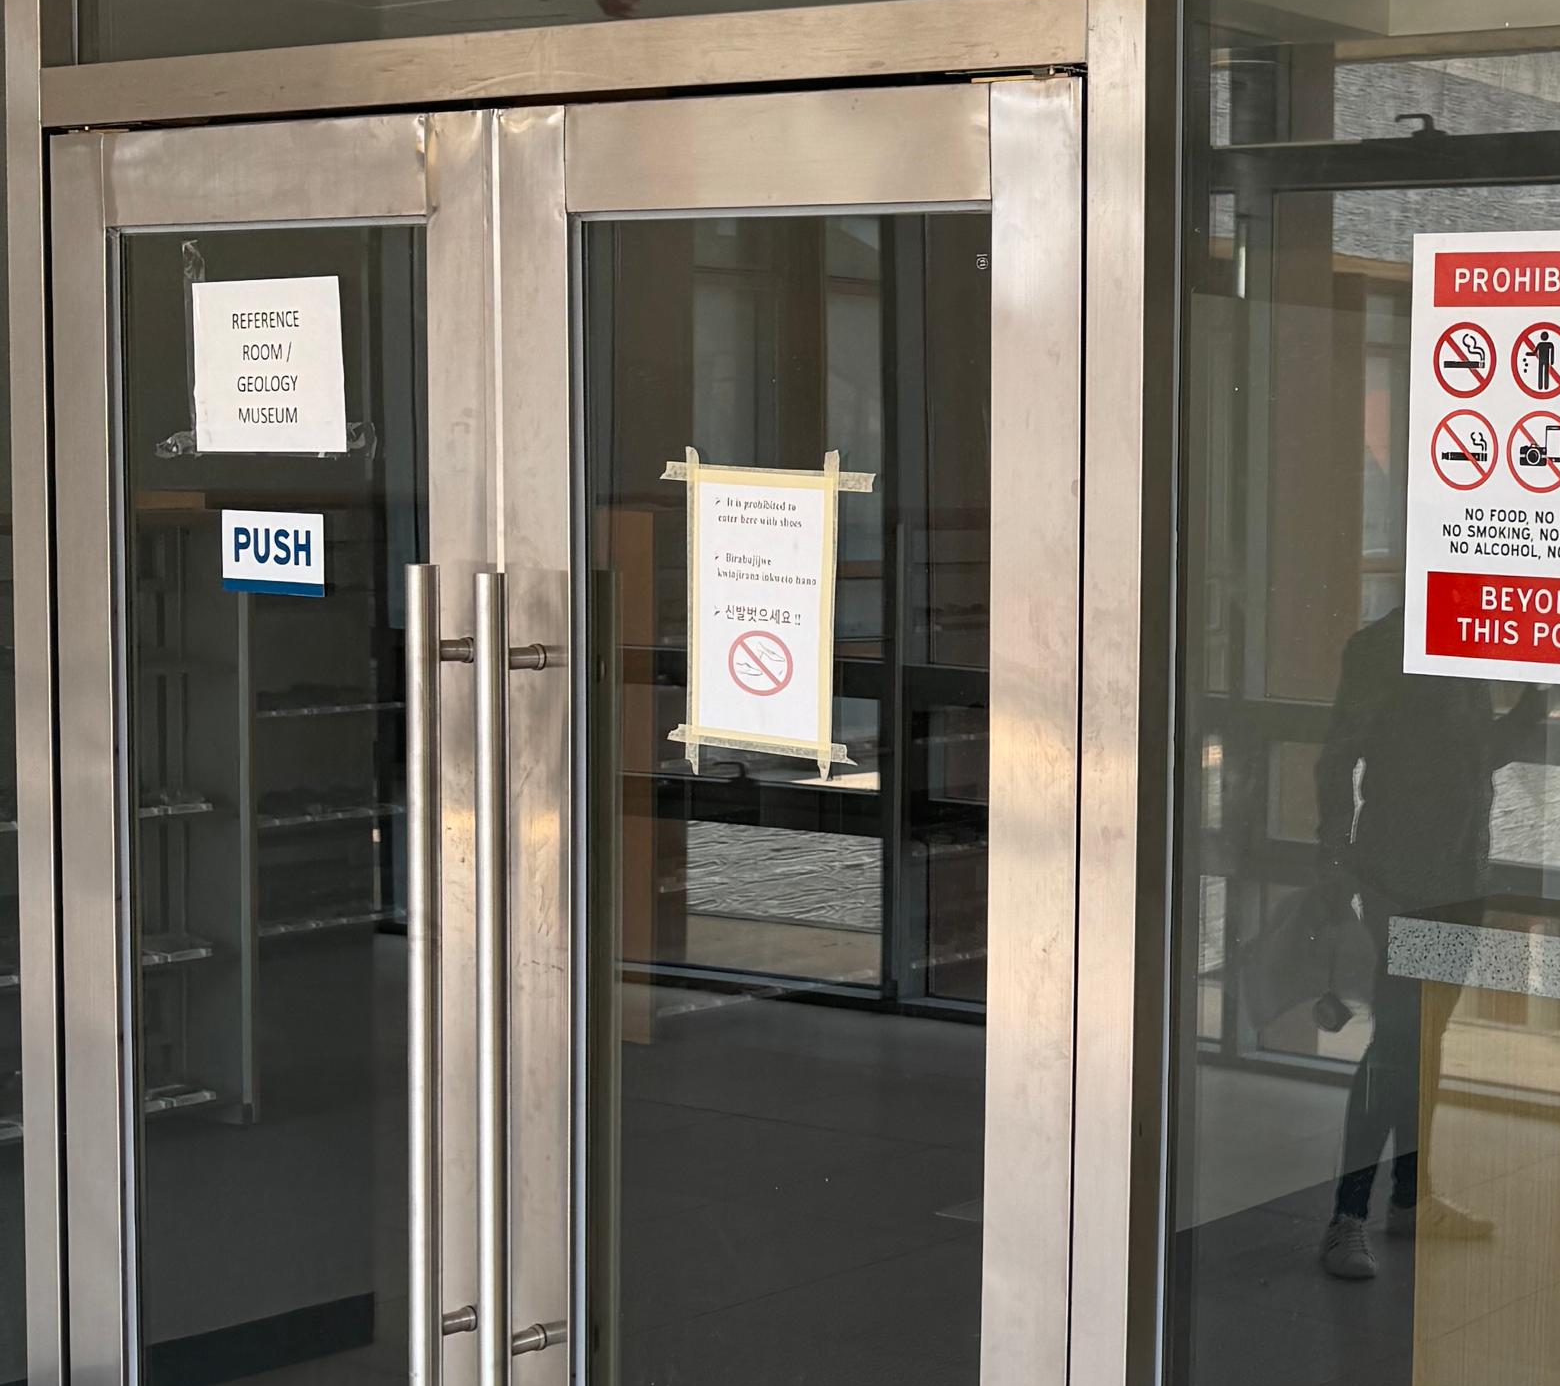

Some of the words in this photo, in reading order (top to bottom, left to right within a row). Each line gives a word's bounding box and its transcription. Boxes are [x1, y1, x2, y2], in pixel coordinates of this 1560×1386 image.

[231, 310, 300, 330] REFERENCE
[242, 343, 283, 361] ROOM
[286, 341, 293, 363] /
[237, 375, 299, 393] GEOLOGY
[238, 406, 299, 424] MUSEUM
[726, 497, 734, 507] It
[735, 499, 742, 508] is
[743, 499, 786, 512] prohibited
[788, 502, 797, 512] to
[717, 514, 738, 523] enter
[740, 514, 758, 525] here
[759, 516, 778, 527] with
[780, 517, 802, 528] shoes
[1464, 508, 1485, 522] NO
[1490, 509, 1530, 525] FOOD,
[1535, 511, 1555, 525] NO
[1442, 524, 1462, 538] NO
[1467, 525, 1534, 543] SMOKING,
[1539, 528, 1560, 542] NO
[233, 526, 312, 567] PUSH
[1449, 541, 1469, 554] NO
[1474, 542, 1542, 561] ALCOHOL,
[725, 604, 792, 625] 신발벗으세요
[1456, 617, 1520, 645] THIS
